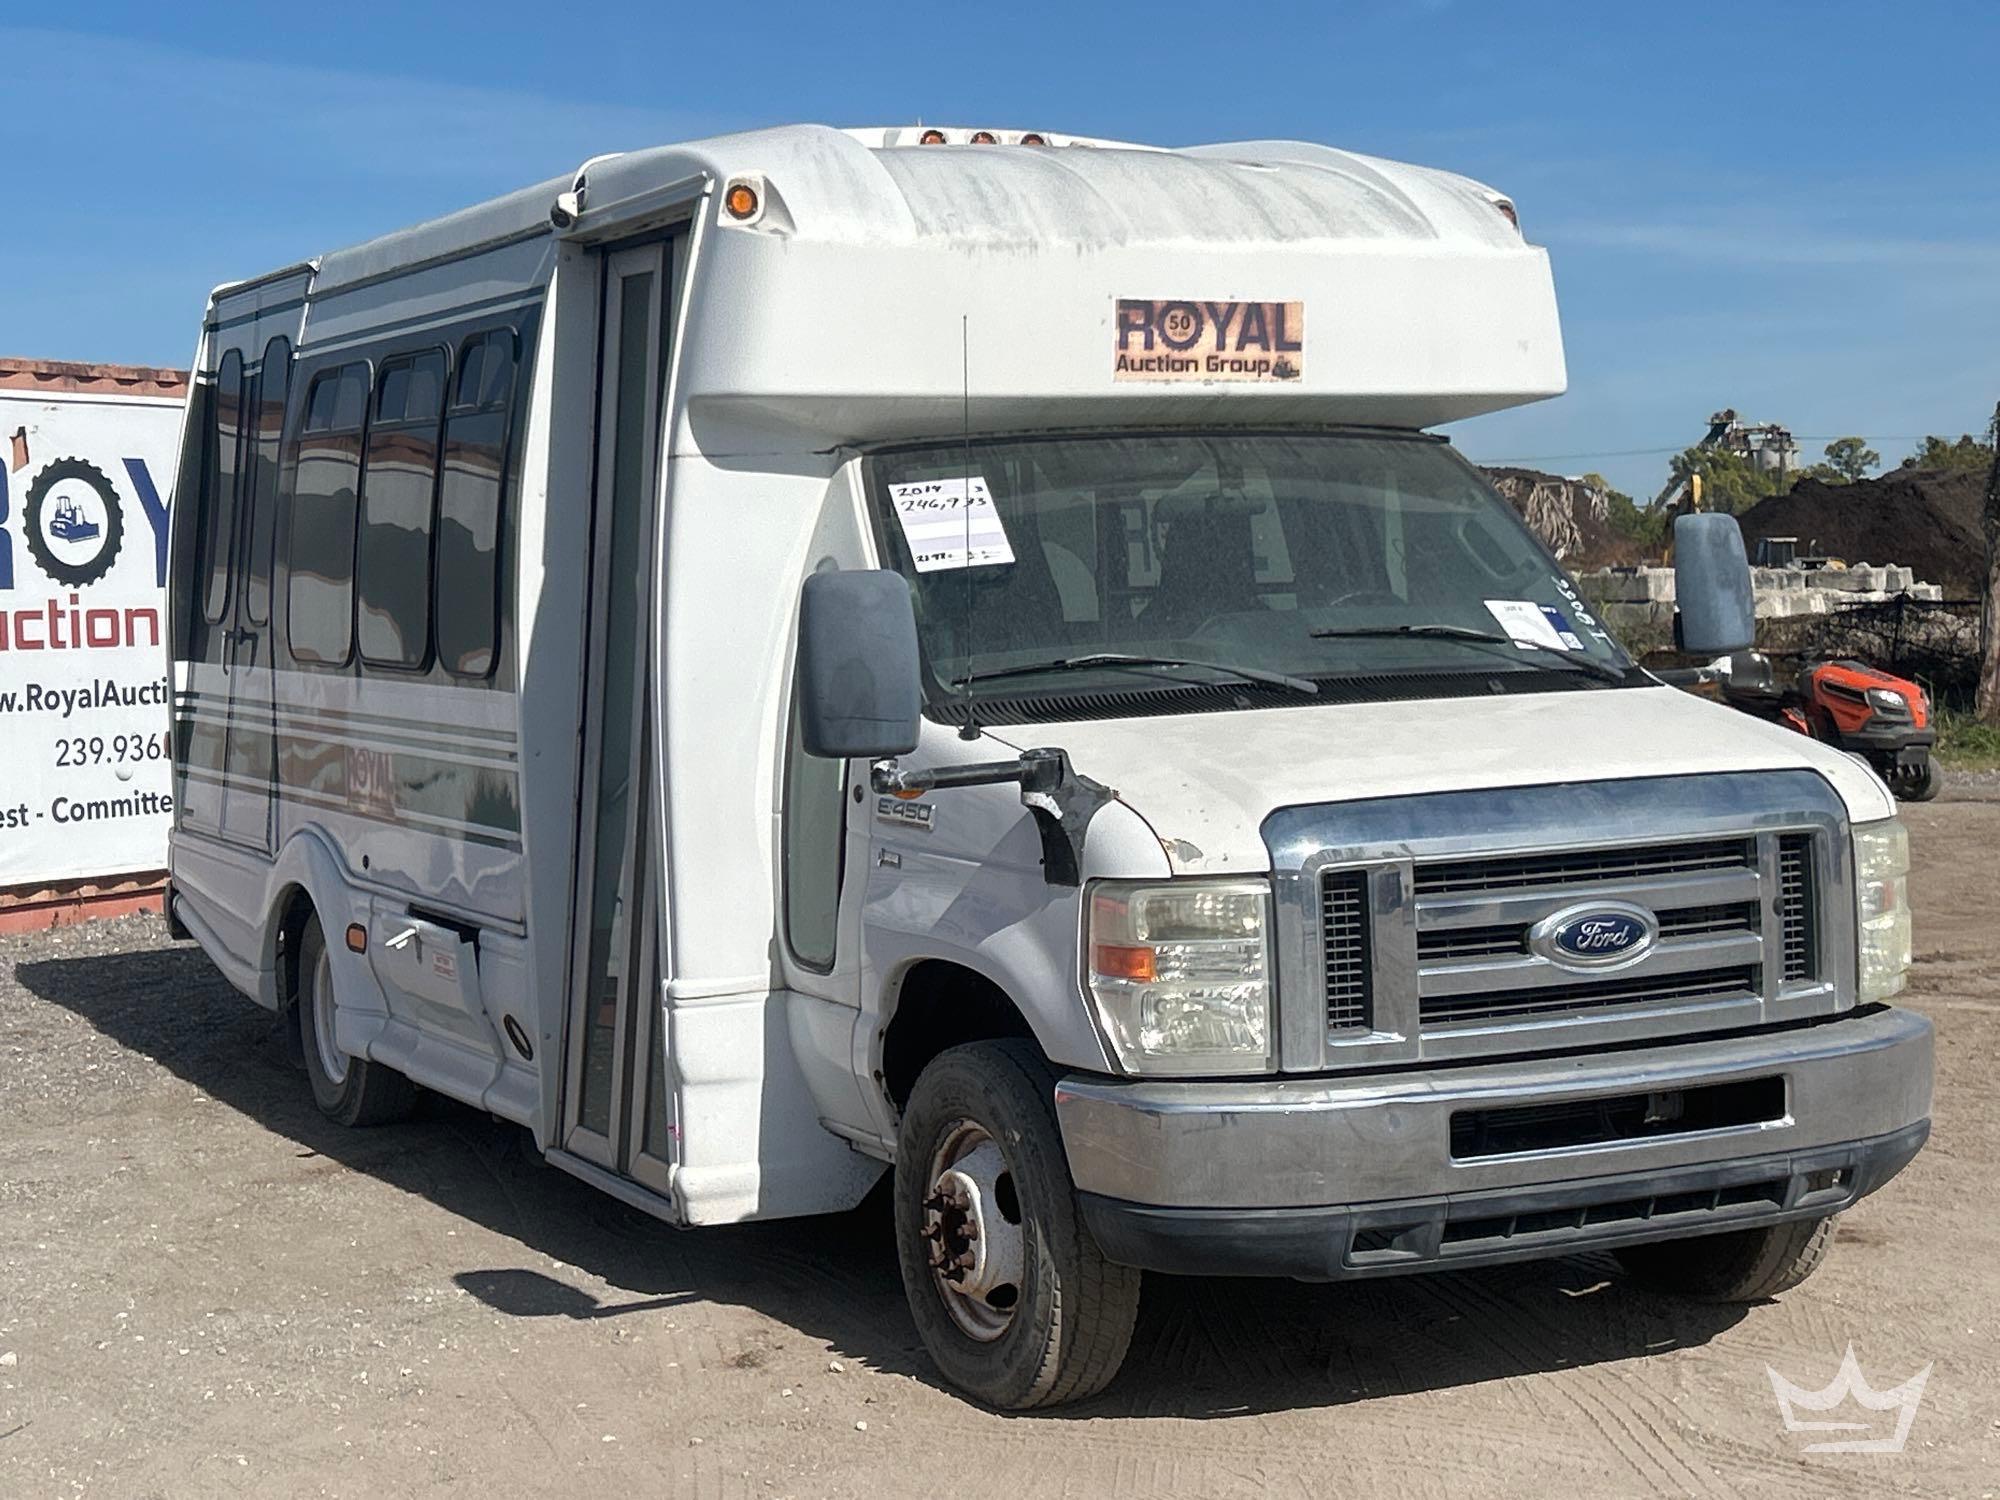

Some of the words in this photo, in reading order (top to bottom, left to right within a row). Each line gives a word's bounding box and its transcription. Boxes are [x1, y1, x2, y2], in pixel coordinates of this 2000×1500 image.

[1118, 300, 1301, 351] ROYAL
[1169, 315, 1190, 330] 50
[1116, 355, 1198, 372] Auction
[1206, 356, 1270, 377] Group
[1576, 920, 1631, 950] Ford
